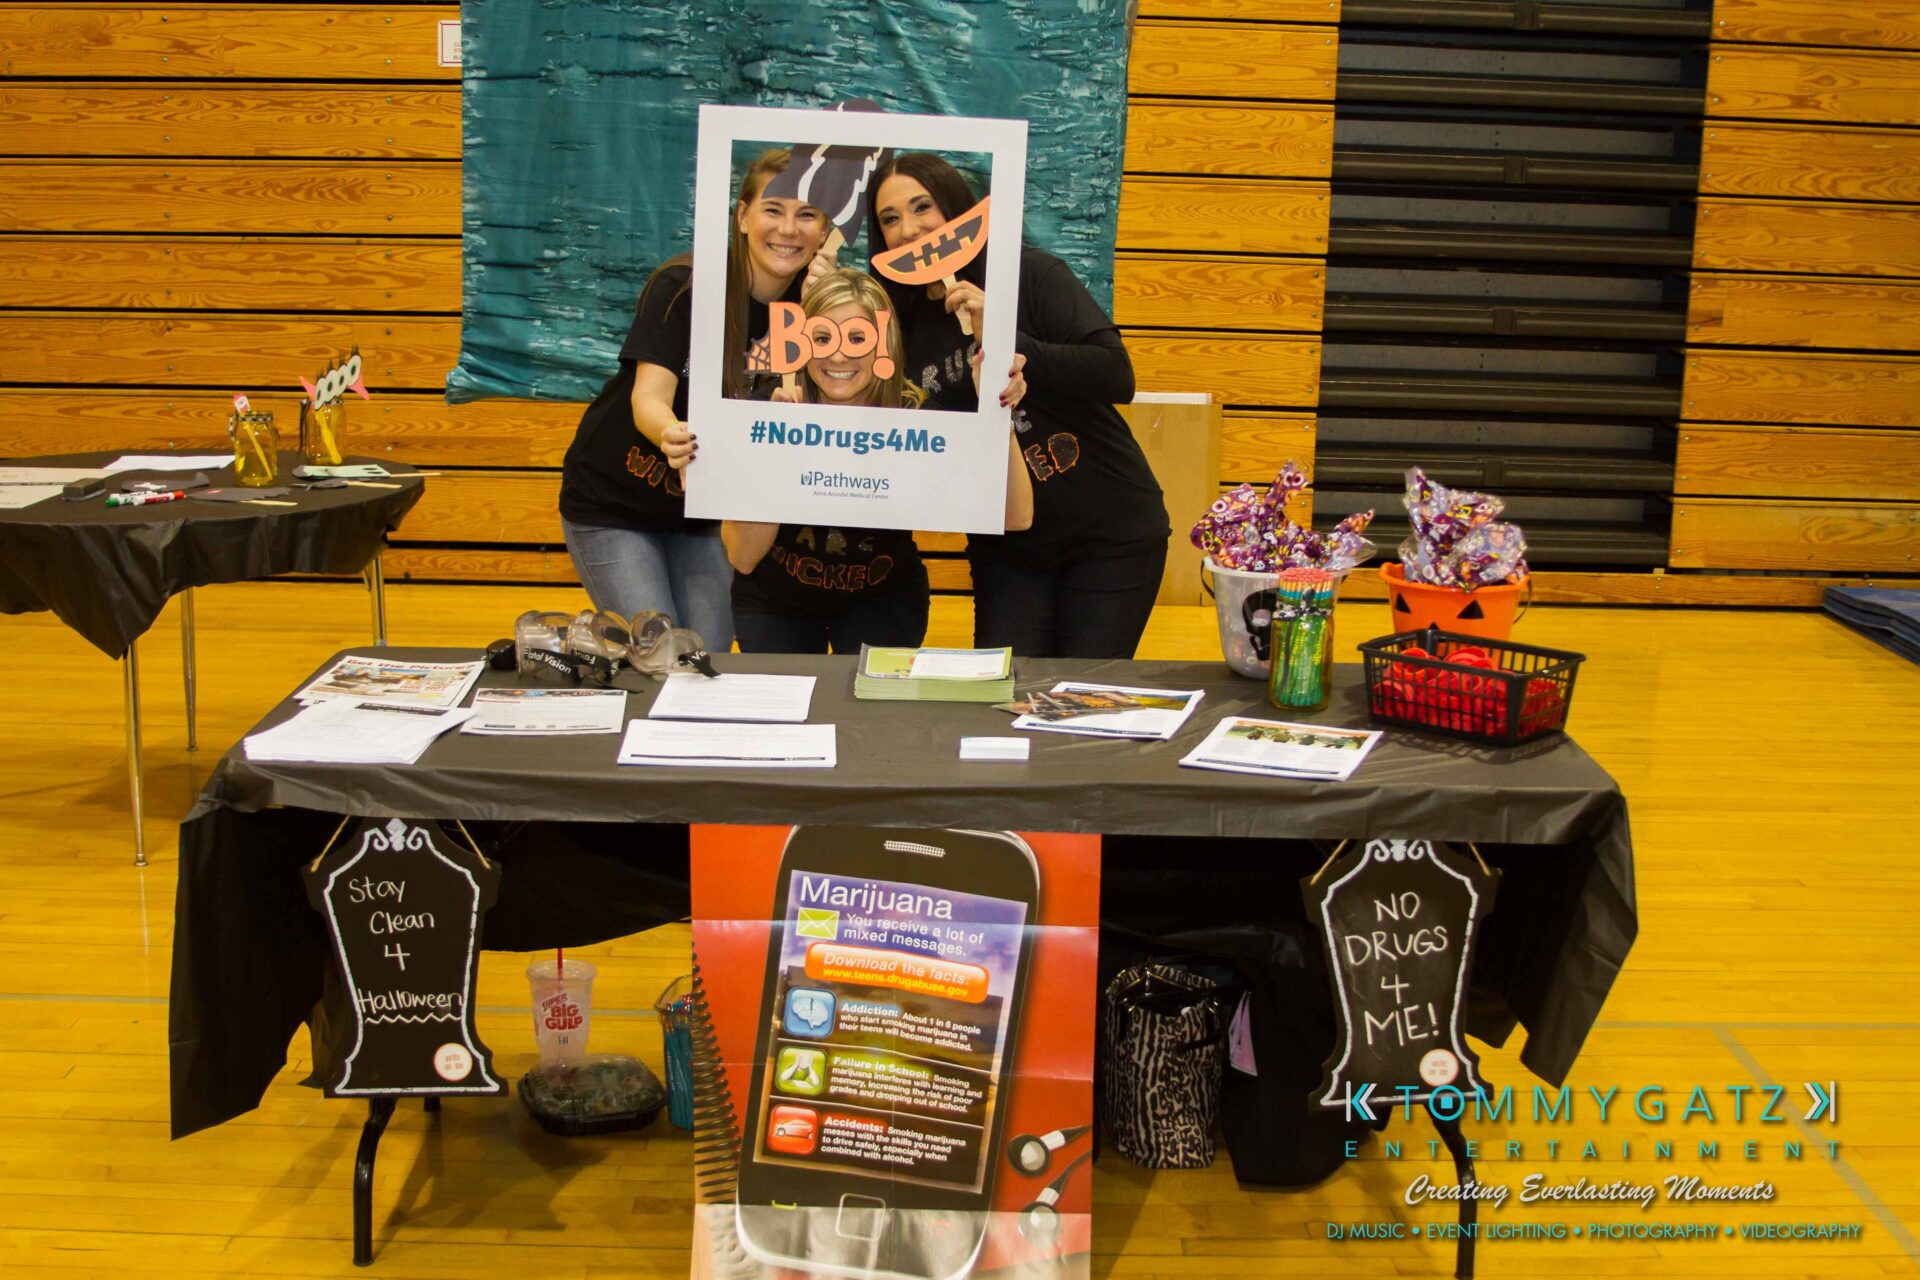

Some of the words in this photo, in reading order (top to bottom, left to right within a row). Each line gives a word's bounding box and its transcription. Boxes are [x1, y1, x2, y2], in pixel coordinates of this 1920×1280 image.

[768, 301, 895, 380] Boo!
[750, 420, 946, 455] #NoDrugs4Me
[813, 471, 890, 493] Pathways
[544, 653, 572, 674] Vision
[349, 876, 405, 903] Stay
[800, 876, 953, 919] Marijuana
[1374, 891, 1420, 922] NO
[370, 910, 434, 934] Clean
[847, 912, 872, 927] You
[877, 918, 927, 935] receive
[933, 927, 940, 937] a
[946, 928, 964, 941] lot
[969, 932, 984, 944] of
[384, 943, 411, 971] 4
[844, 928, 887, 943] mixed
[892, 933, 966, 957] messages.
[1345, 925, 1448, 965] DRUGS
[823, 968, 968, 997] www.teens.drugabuse.gov
[824, 953, 898, 972] Download
[902, 961, 924, 976] the
[929, 967, 970, 985] facts:
[357, 988, 463, 1014] Halloween
[1381, 974, 1410, 1004] 4
[545, 1015, 583, 1030] GULP
[840, 1014, 858, 1023] who
[860, 1016, 880, 1024] start
[882, 1019, 916, 1032] smoking
[917, 1024, 958, 1039] marijuana
[960, 1033, 968, 1041] in
[841, 1003, 898, 1017] Addiction:
[903, 1013, 927, 1024] About
[936, 1019, 944, 1027] in
[952, 1023, 981, 1035] people
[1364, 1002, 1440, 1046] ME!
[839, 1022, 858, 1031] their
[860, 1024, 883, 1033] teens
[885, 1028, 899, 1036] will
[900, 1031, 933, 1043] become
[935, 1037, 972, 1051] addicted.
[832, 1067, 872, 1079] marijuana
[874, 1072, 912, 1085] interferes
[914, 1079, 931, 1089] with
[932, 1083, 965, 1096] learning
[967, 1090, 982, 1098] and
[834, 1057, 872, 1070] Failure
[875, 1063, 885, 1072] in
[889, 1065, 929, 1080] School:
[934, 1075, 970, 1088] Smoking
[830, 1085, 858, 1095] grades
[859, 1088, 875, 1097] and
[876, 1091, 912, 1104] dropping
[929, 1099, 937, 1107] of
[939, 1101, 968, 1112] school.
[831, 1077, 866, 1088] memory,
[868, 1080, 911, 1095] increasing
[912, 1087, 925, 1096] the
[927, 1089, 942, 1098] risk
[943, 1093, 952, 1101] of
[954, 1096, 973, 1105] poor
[823, 1127, 855, 1138] messes
[857, 1131, 874, 1140] with
[877, 1134, 889, 1142] the
[891, 1137, 912, 1147] skills
[914, 1140, 929, 1150] you
[930, 1143, 952, 1153] need
[824, 1117, 883, 1133] Accidents:
[888, 1126, 924, 1140] Smoking
[925, 1134, 966, 1147] marijuana
[821, 1145, 862, 1157] combined
[864, 1150, 881, 1159] with
[882, 1153, 915, 1165] alcohol.
[833, 1137, 853, 1146] drive
[855, 1139, 881, 1152] safely,
[882, 1144, 923, 1159] especially
[925, 1152, 948, 1162] when
